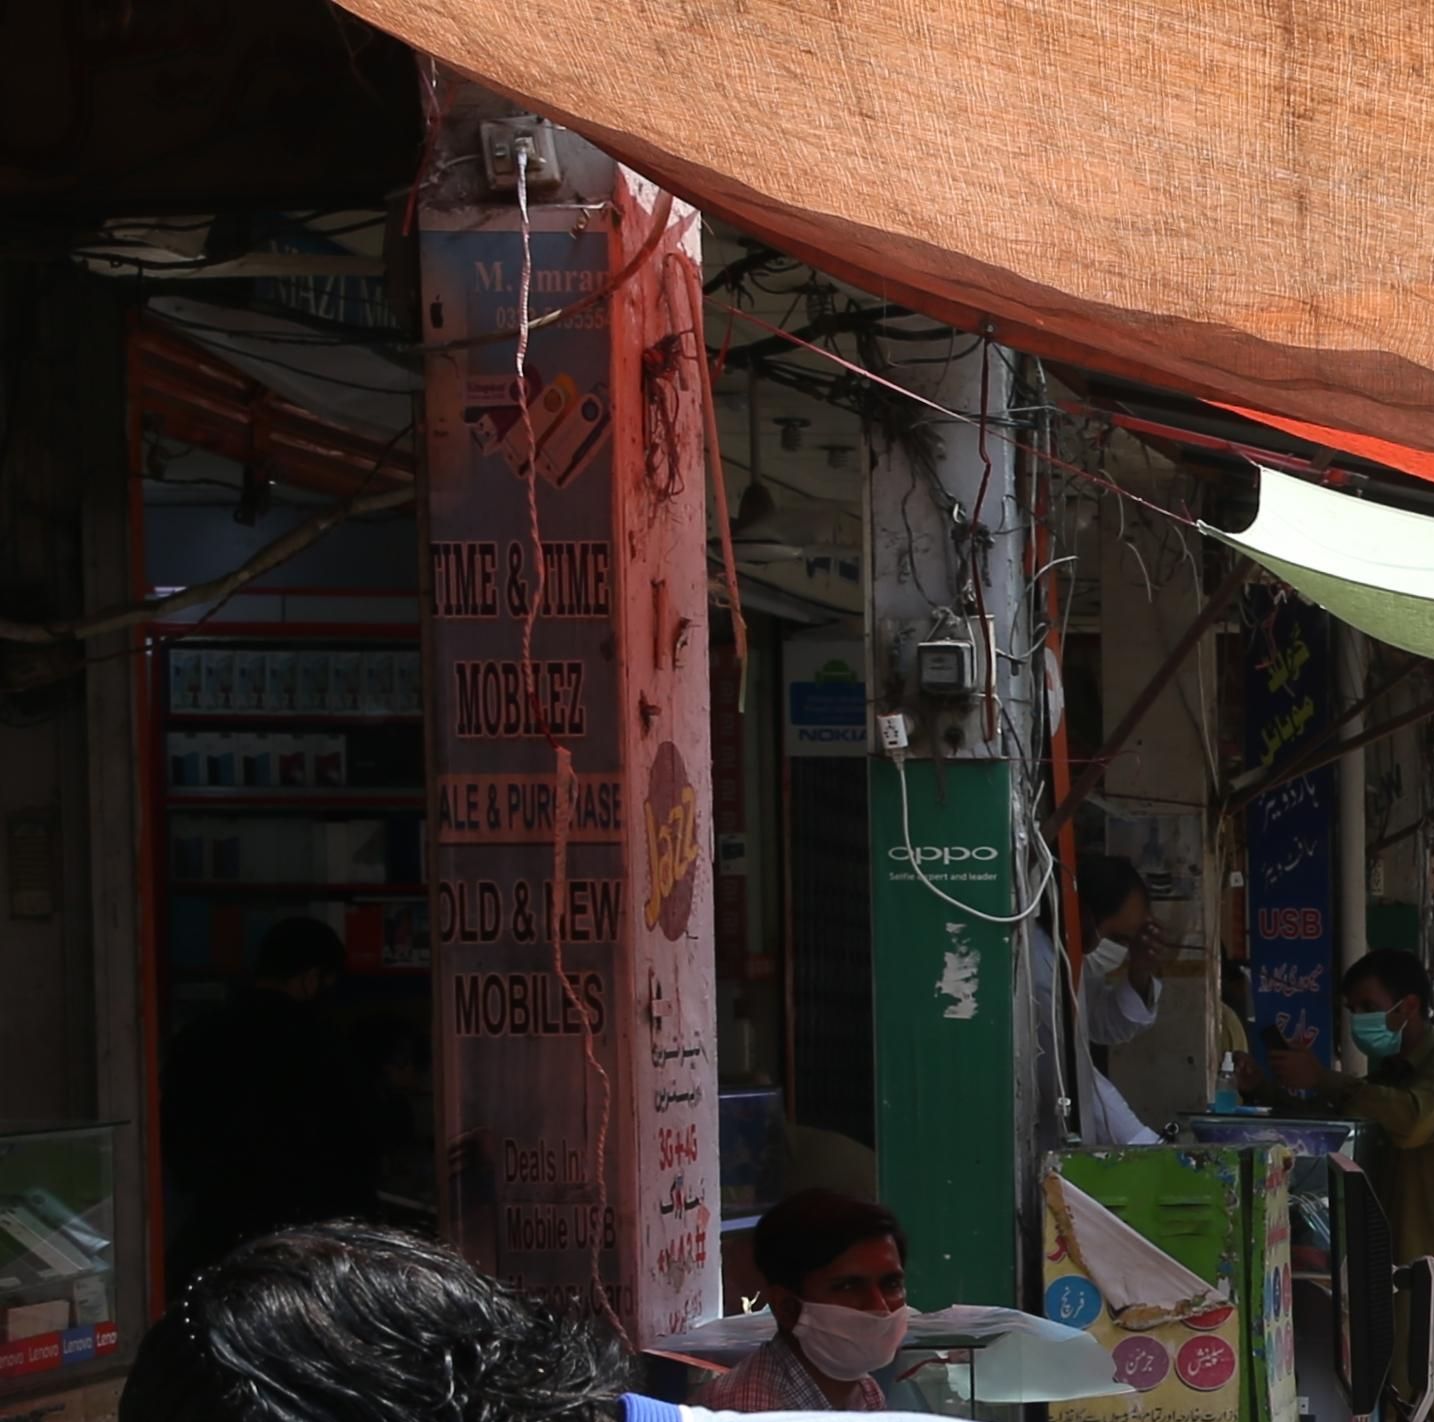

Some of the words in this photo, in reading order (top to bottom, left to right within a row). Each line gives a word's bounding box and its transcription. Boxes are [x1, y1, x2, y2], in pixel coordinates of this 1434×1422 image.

[540, 541, 609, 618] TIME
[455, 659, 586, 738] MOBILEZ
[438, 783, 480, 830] ALE
[486, 783, 501, 830] &
[644, 786, 698, 932] Jazz
[888, 846, 998, 865] oppo
[950, 872, 967, 881] and
[968, 872, 998, 881] leader
[512, 882, 535, 942] &
[1259, 907, 1322, 939] USB
[455, 974, 605, 1035] MOBILES
[503, 1139, 556, 1183] Deals
[505, 1206, 568, 1250] Mobile
